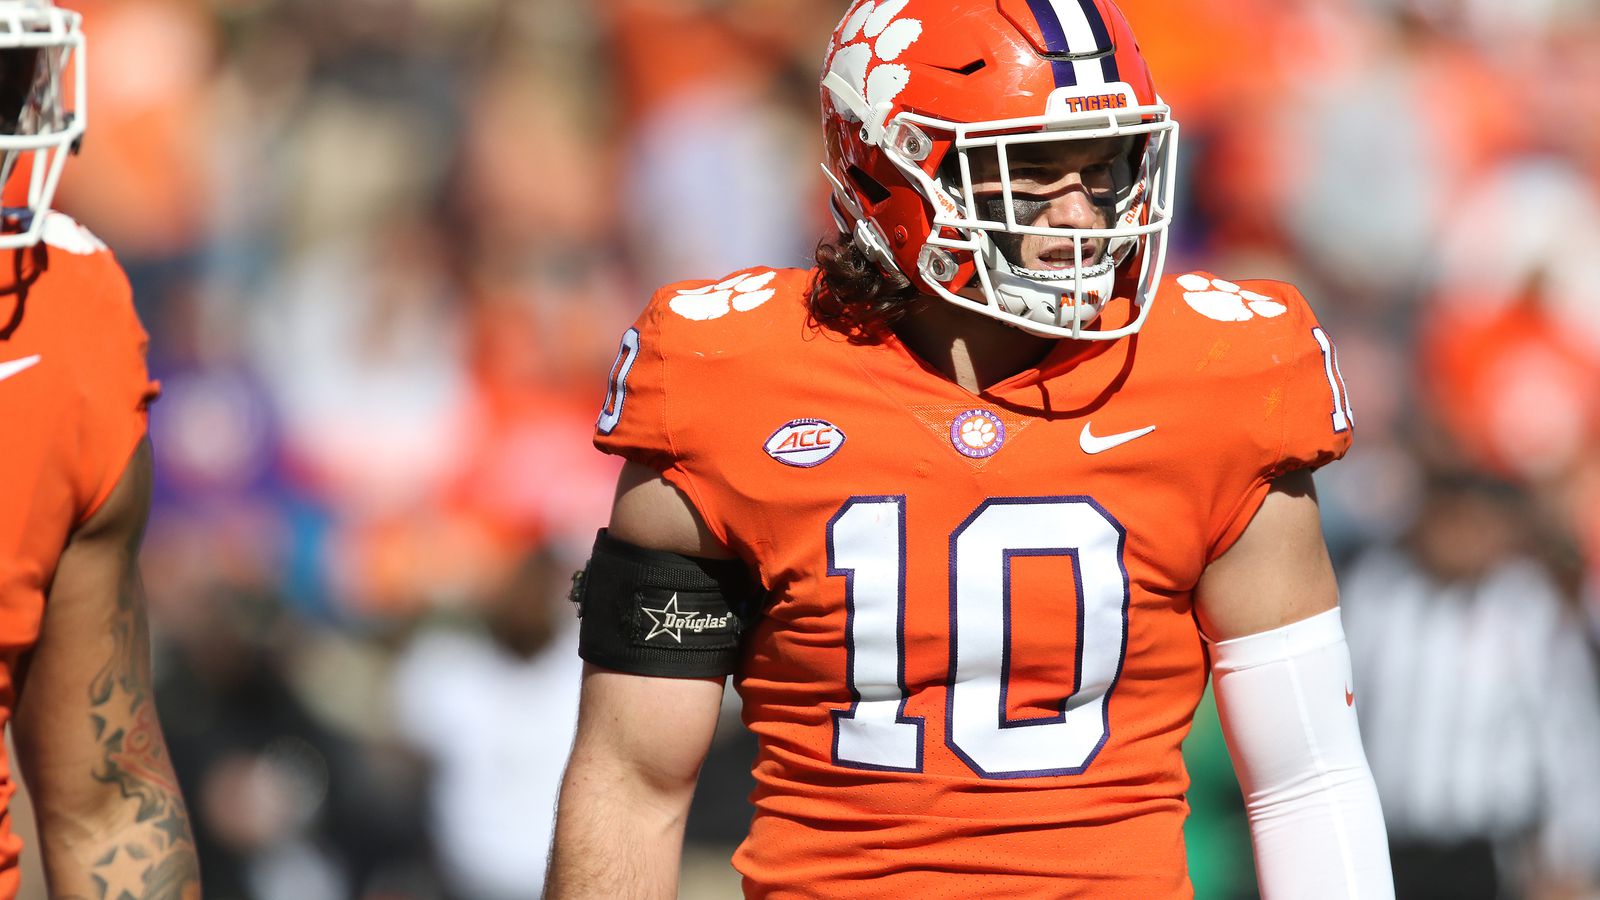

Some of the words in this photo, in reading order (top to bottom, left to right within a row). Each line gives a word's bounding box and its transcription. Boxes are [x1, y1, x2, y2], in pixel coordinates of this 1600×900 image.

[1065, 93, 1127, 113] TIGERS
[954, 409, 1002, 427] CLEMSON
[777, 428, 832, 449] ACC
[952, 437, 1003, 456] GRADUATE
[663, 613, 727, 632] Douglas
[826, 494, 1130, 780] 10
